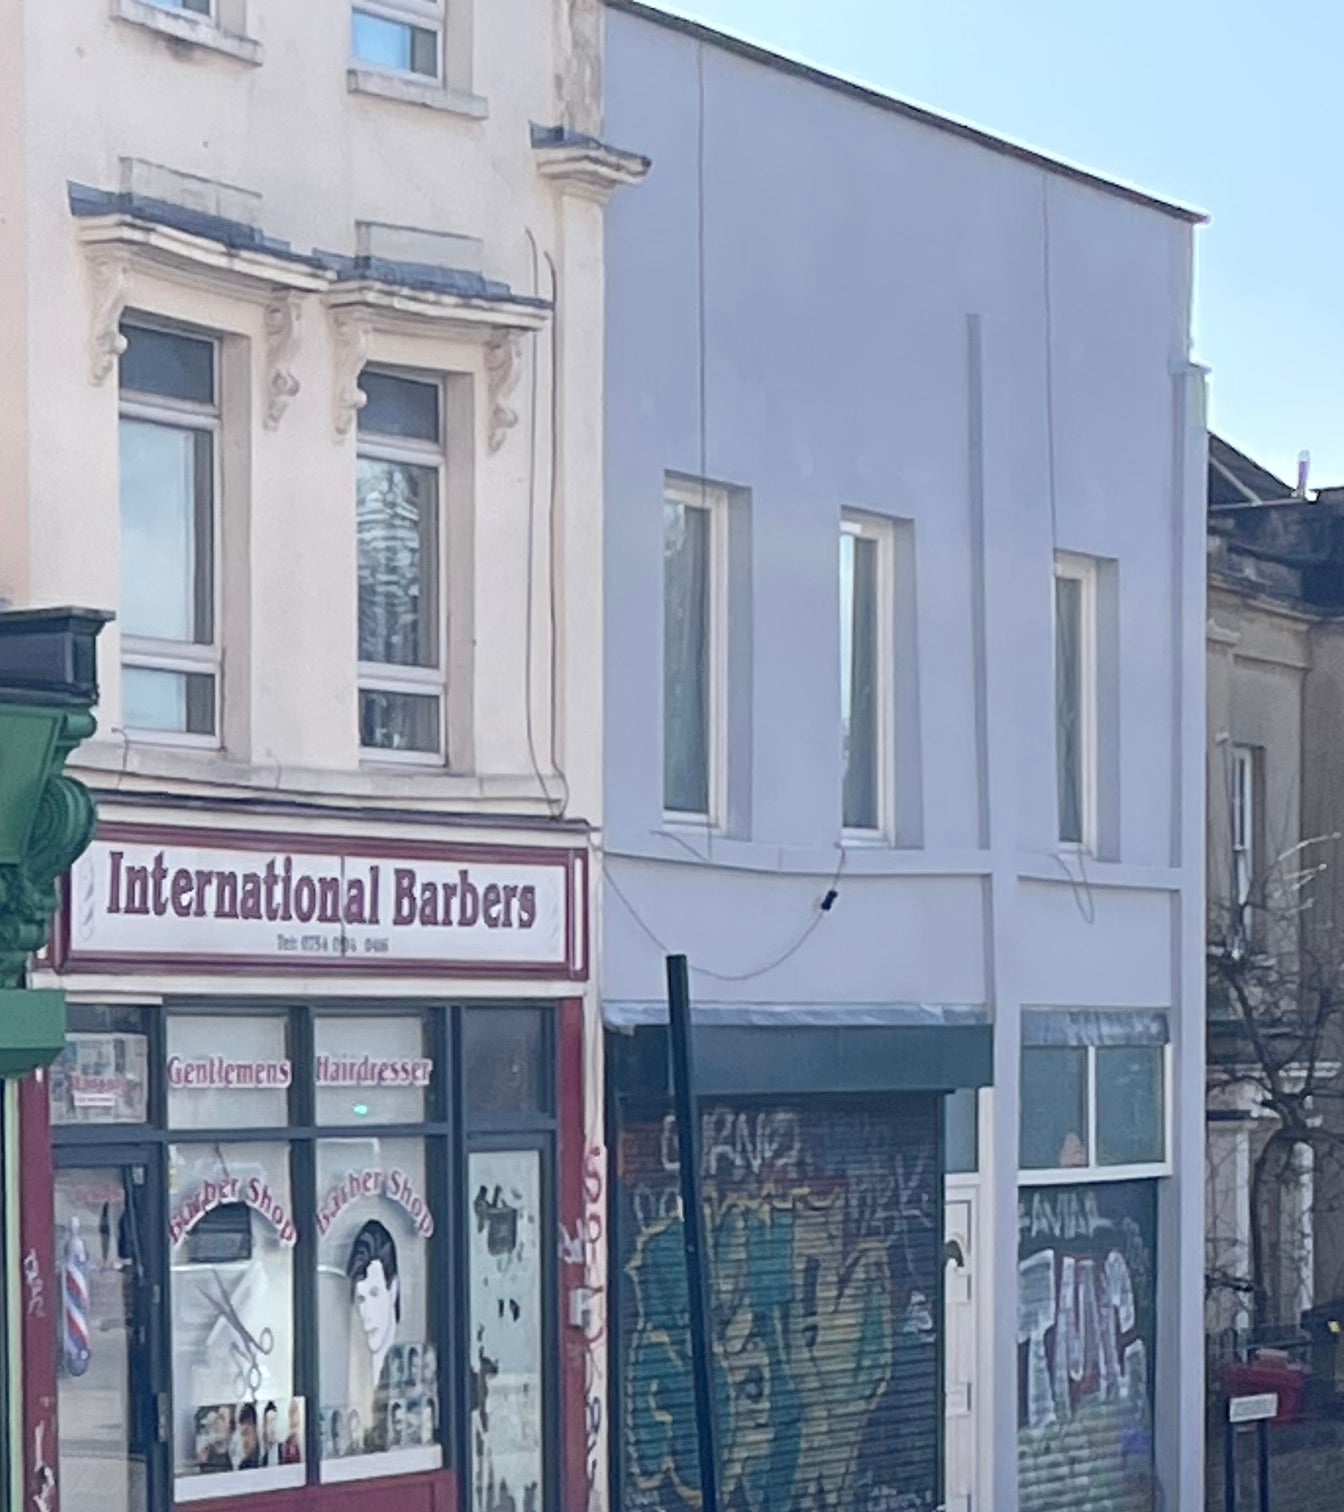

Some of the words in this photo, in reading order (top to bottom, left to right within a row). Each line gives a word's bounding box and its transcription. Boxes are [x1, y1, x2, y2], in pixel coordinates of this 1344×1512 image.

[106, 850, 382, 926] International
[391, 866, 538, 929] Barbers
[167, 1055, 292, 1087] Gentlemens
[315, 1054, 433, 1087] Hairdresser
[247, 1177, 297, 1246] Shop
[389, 1168, 436, 1240] Shop
